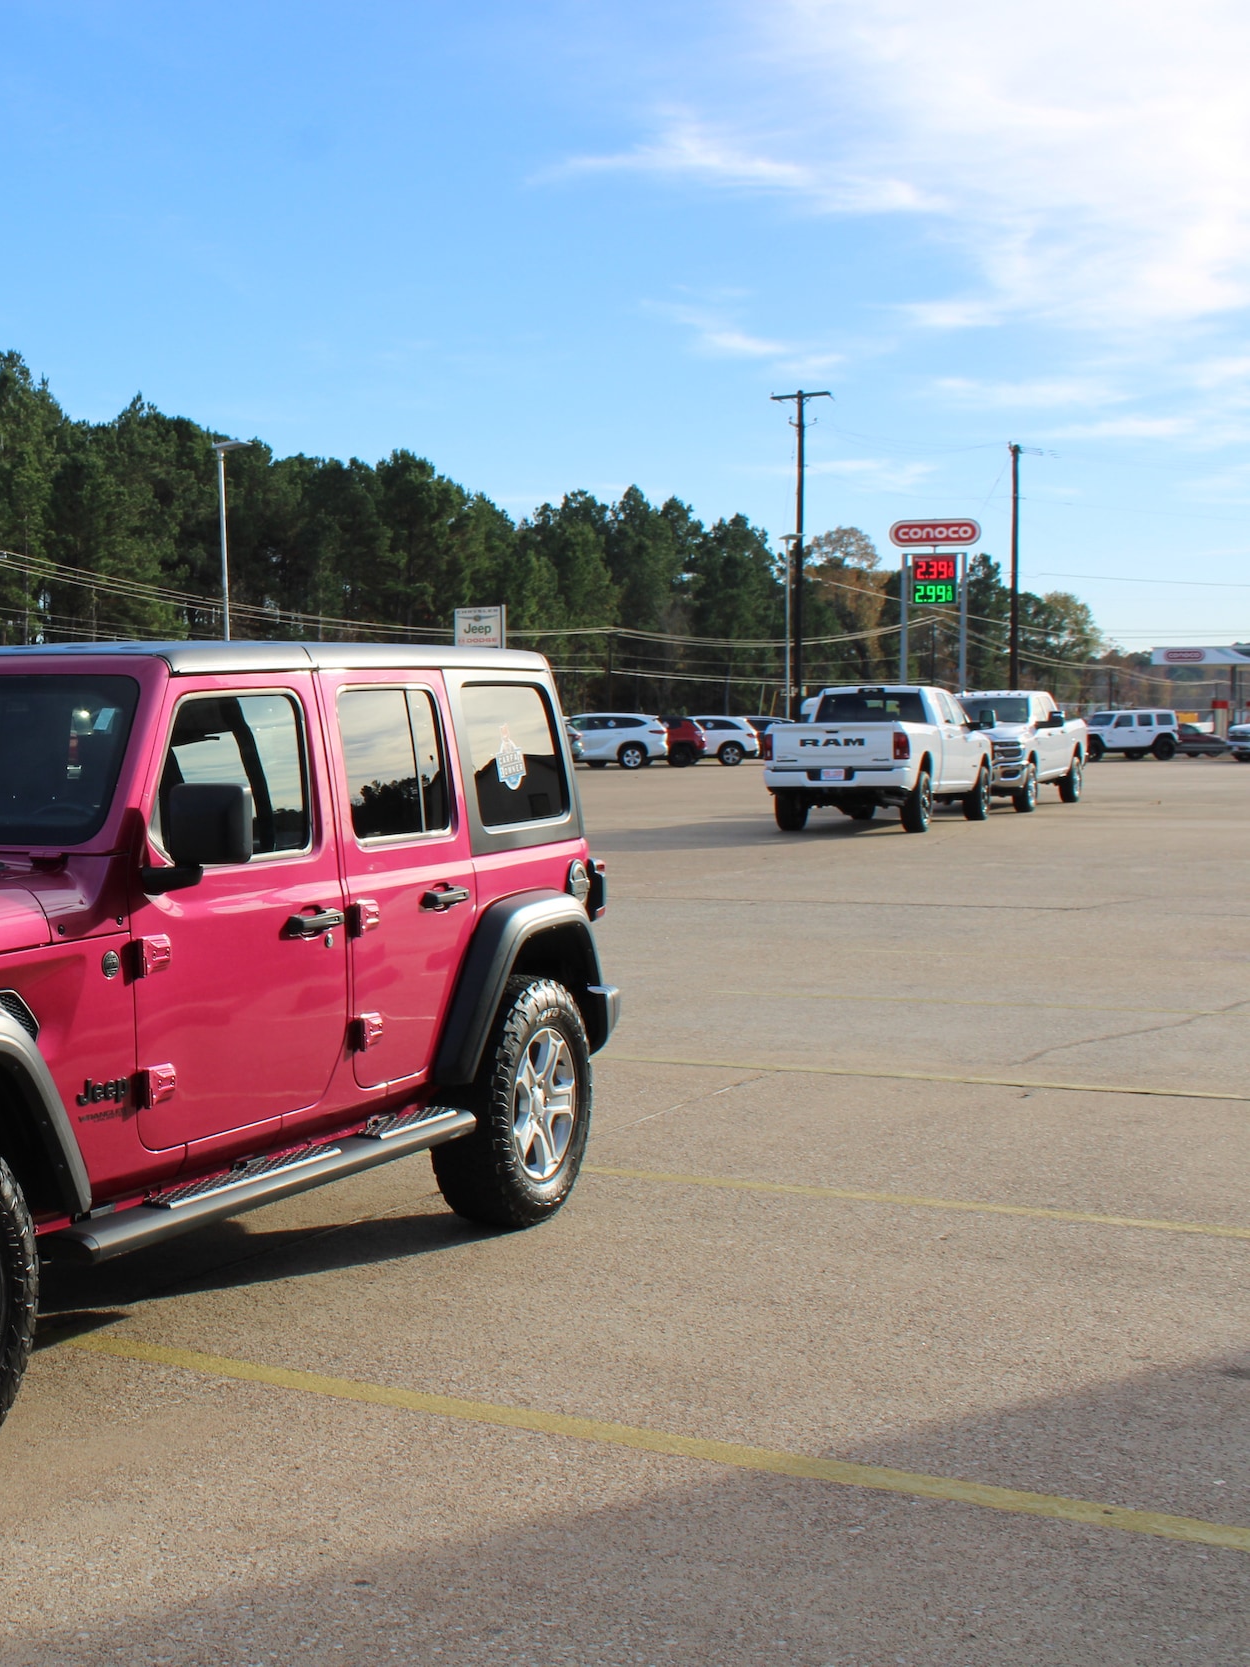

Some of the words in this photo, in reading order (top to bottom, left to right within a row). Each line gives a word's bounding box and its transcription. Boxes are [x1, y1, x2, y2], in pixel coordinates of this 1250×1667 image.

[463, 623, 492, 635] Jeep
[799, 738, 865, 747] RAM
[75, 1077, 128, 1106] Jeep
